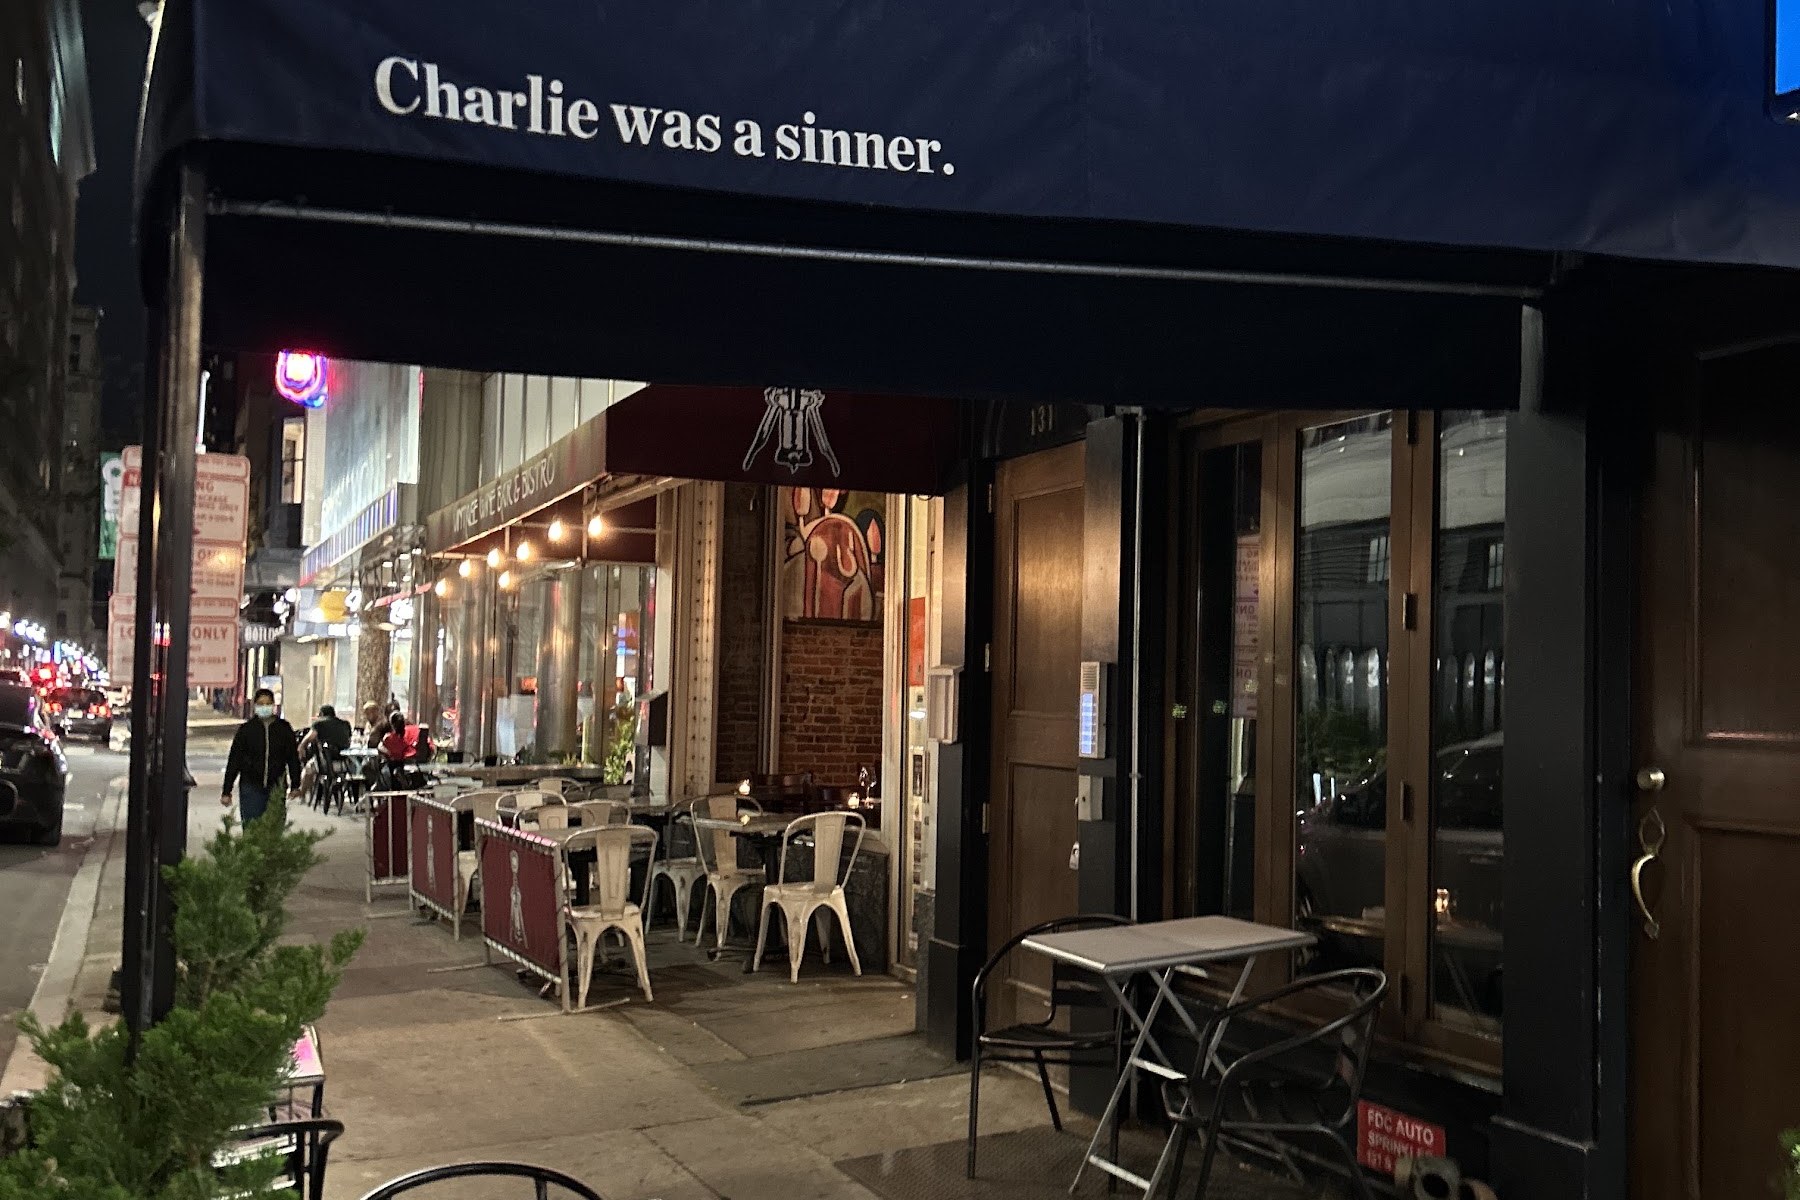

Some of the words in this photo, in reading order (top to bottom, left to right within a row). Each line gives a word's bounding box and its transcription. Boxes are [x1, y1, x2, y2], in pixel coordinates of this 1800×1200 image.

[374, 55, 598, 141] Charlie
[611, 103, 721, 152] was
[734, 118, 766, 158] a
[776, 111, 956, 176] sinner.
[1031, 404, 1054, 436] 131
[192, 626, 228, 640] ONLY
[1367, 1108, 1392, 1132] FDC
[1396, 1118, 1434, 1146] AUTO
